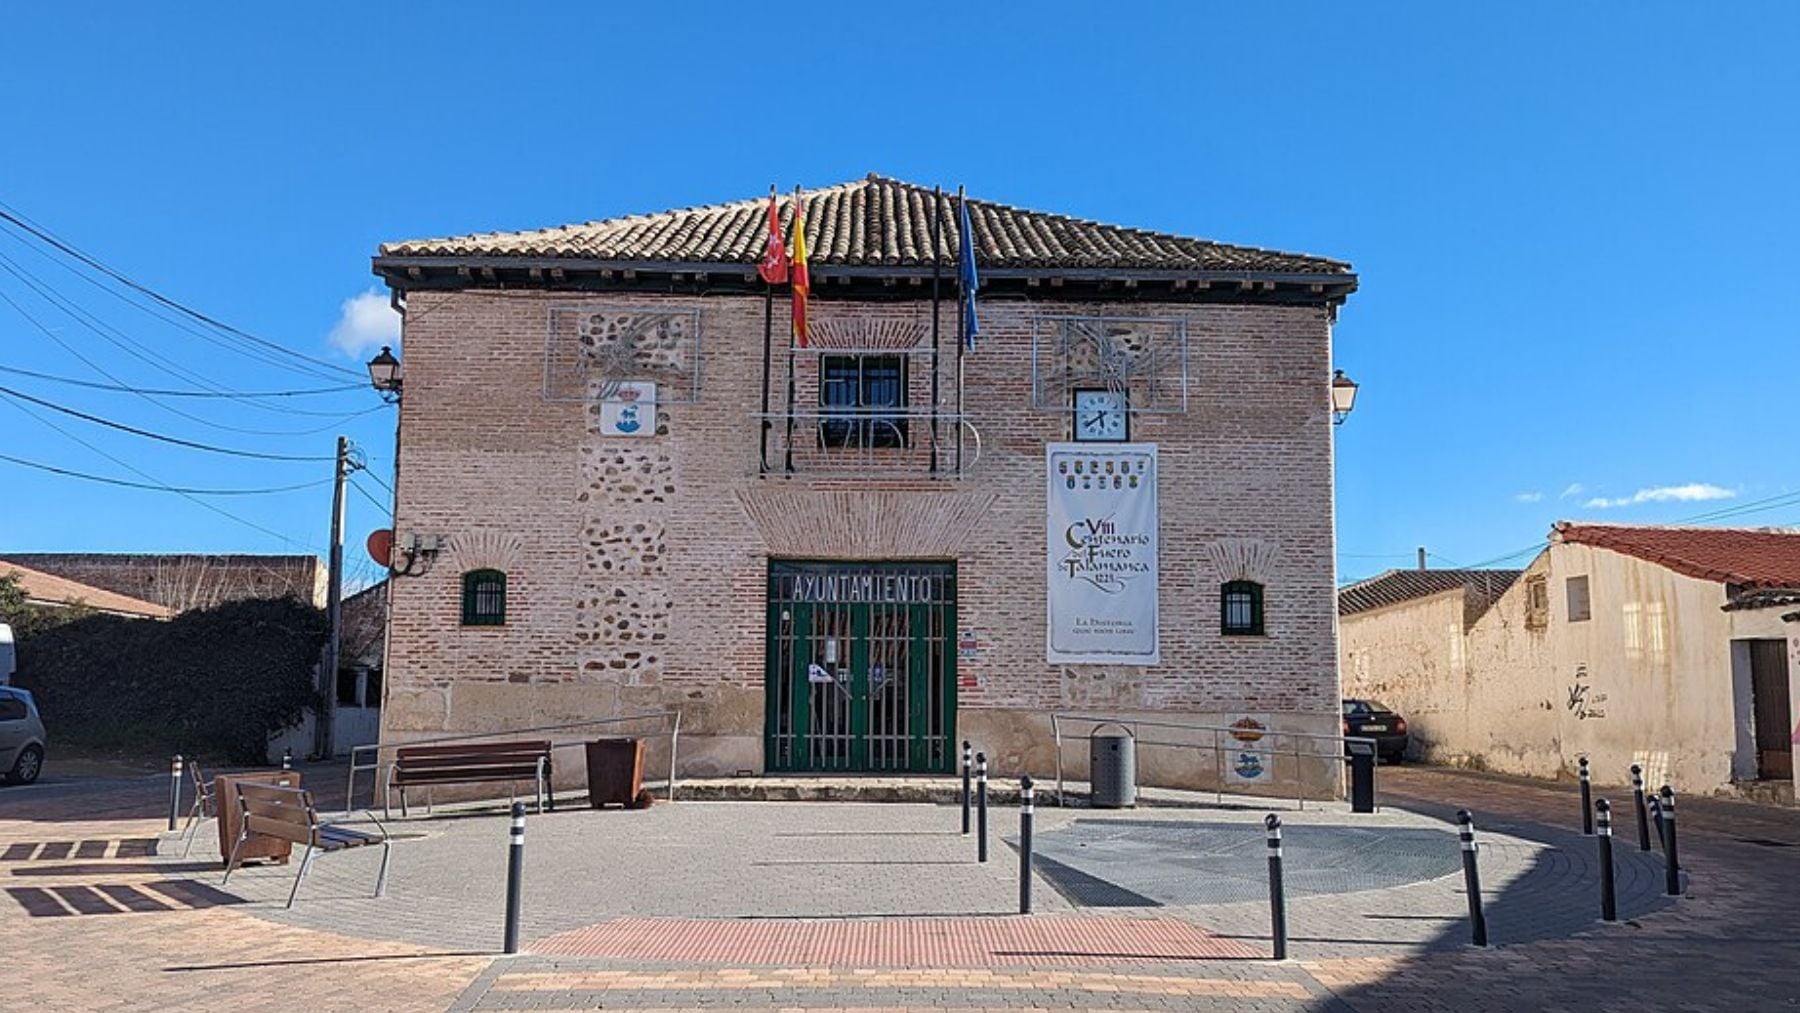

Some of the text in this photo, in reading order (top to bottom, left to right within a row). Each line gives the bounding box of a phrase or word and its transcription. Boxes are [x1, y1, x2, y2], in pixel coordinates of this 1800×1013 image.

[1066, 521, 1149, 549] Centenario
[1087, 545, 1131, 562] Fuero
[1064, 558, 1149, 579] Talamanca
[793, 575, 931, 601] AYUNTAMIENTO
